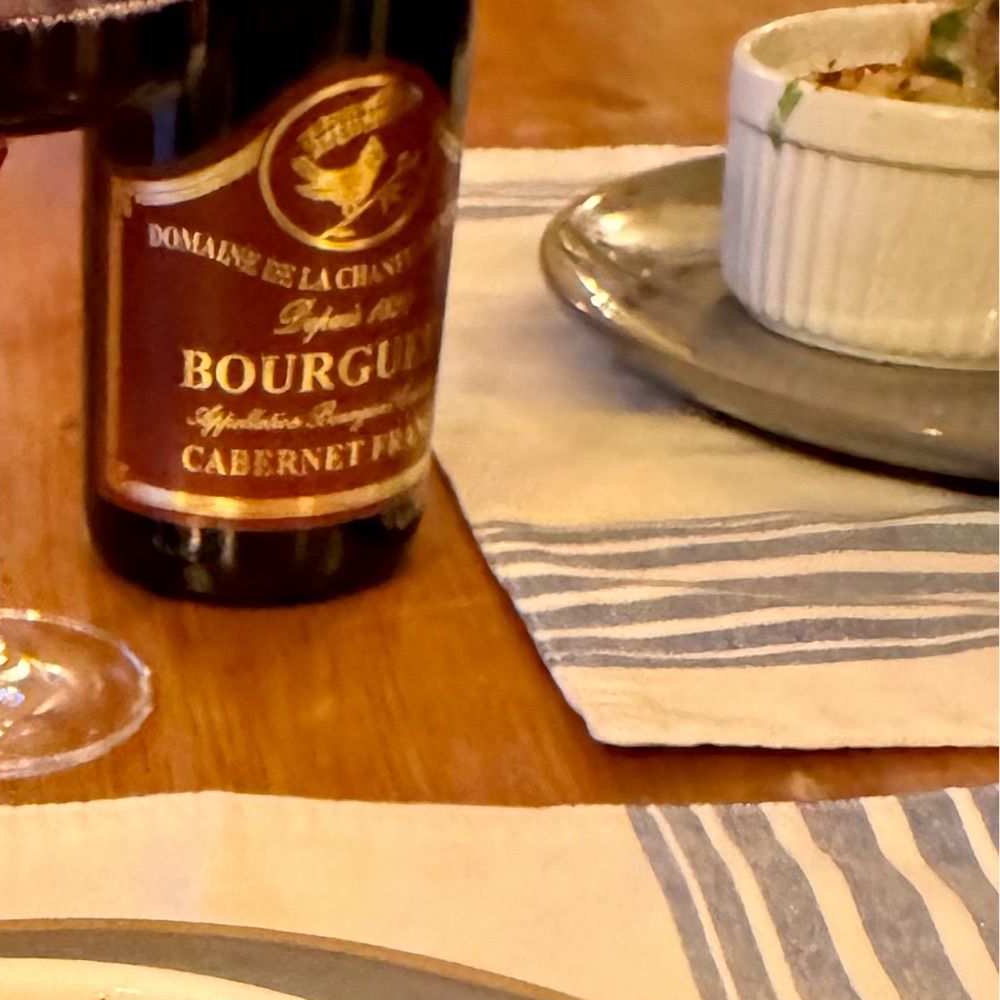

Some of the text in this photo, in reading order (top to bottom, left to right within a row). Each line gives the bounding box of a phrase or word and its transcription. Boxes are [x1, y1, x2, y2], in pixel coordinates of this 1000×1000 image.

[147, 223, 262, 277] DOMAINE
[298, 266, 332, 292] LA
[181, 439, 365, 477] CABERNET
